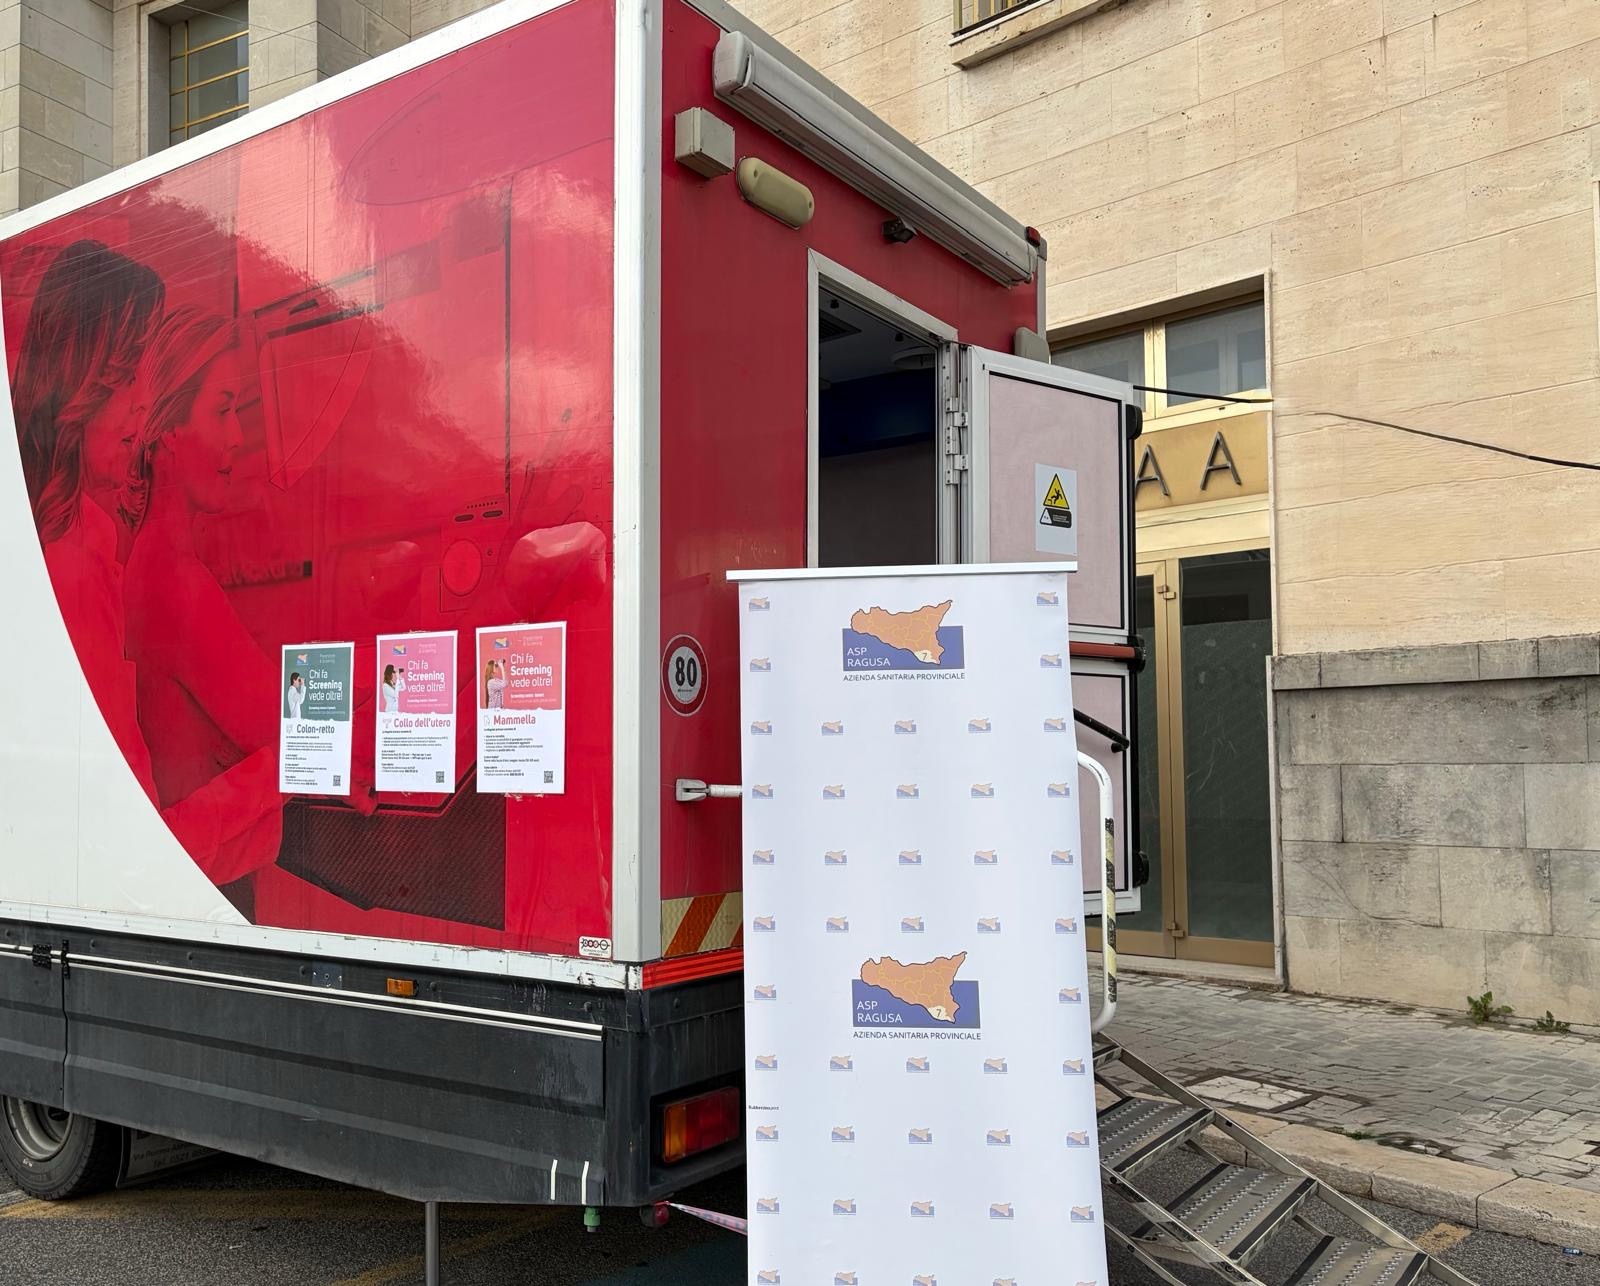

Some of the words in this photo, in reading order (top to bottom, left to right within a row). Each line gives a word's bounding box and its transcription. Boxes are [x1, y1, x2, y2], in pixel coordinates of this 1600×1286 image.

[846, 647, 868, 656] ASP
[922, 652, 928, 661] 7
[510, 653, 524, 664] Chi
[525, 652, 534, 664] fa
[847, 657, 891, 667] RAGUSA
[407, 660, 420, 670] Chi
[421, 659, 429, 670] fa
[309, 669, 320, 679] Chi
[321, 669, 328, 679] fa
[510, 664, 552, 677] Screening
[675, 655, 698, 688] 80
[407, 670, 445, 683] Screening
[510, 677, 530, 688] vede
[531, 676, 553, 687] oltre!
[843, 674, 876, 682] AZIENDA
[876, 673, 915, 681] SANITARIA
[916, 672, 965, 681] PROVINCIALE
[308, 679, 343, 691] Screening
[407, 682, 425, 693] vede
[426, 681, 446, 692] oltre!
[308, 691, 325, 701] vede
[325, 690, 343, 701] oltre!
[393, 717, 413, 728] Collo
[414, 717, 451, 728] dell'utero
[493, 714, 536, 726] Mammella
[296, 723, 335, 734] Colon-retto
[856, 1000, 878, 1011] ASP
[857, 1013, 903, 1024] RAGUSA
[936, 1008, 942, 1018] 7
[853, 1031, 888, 1039] AZIENDA
[888, 1031, 930, 1040] SANITARIA
[930, 1032, 982, 1041] PROVINCIALE
